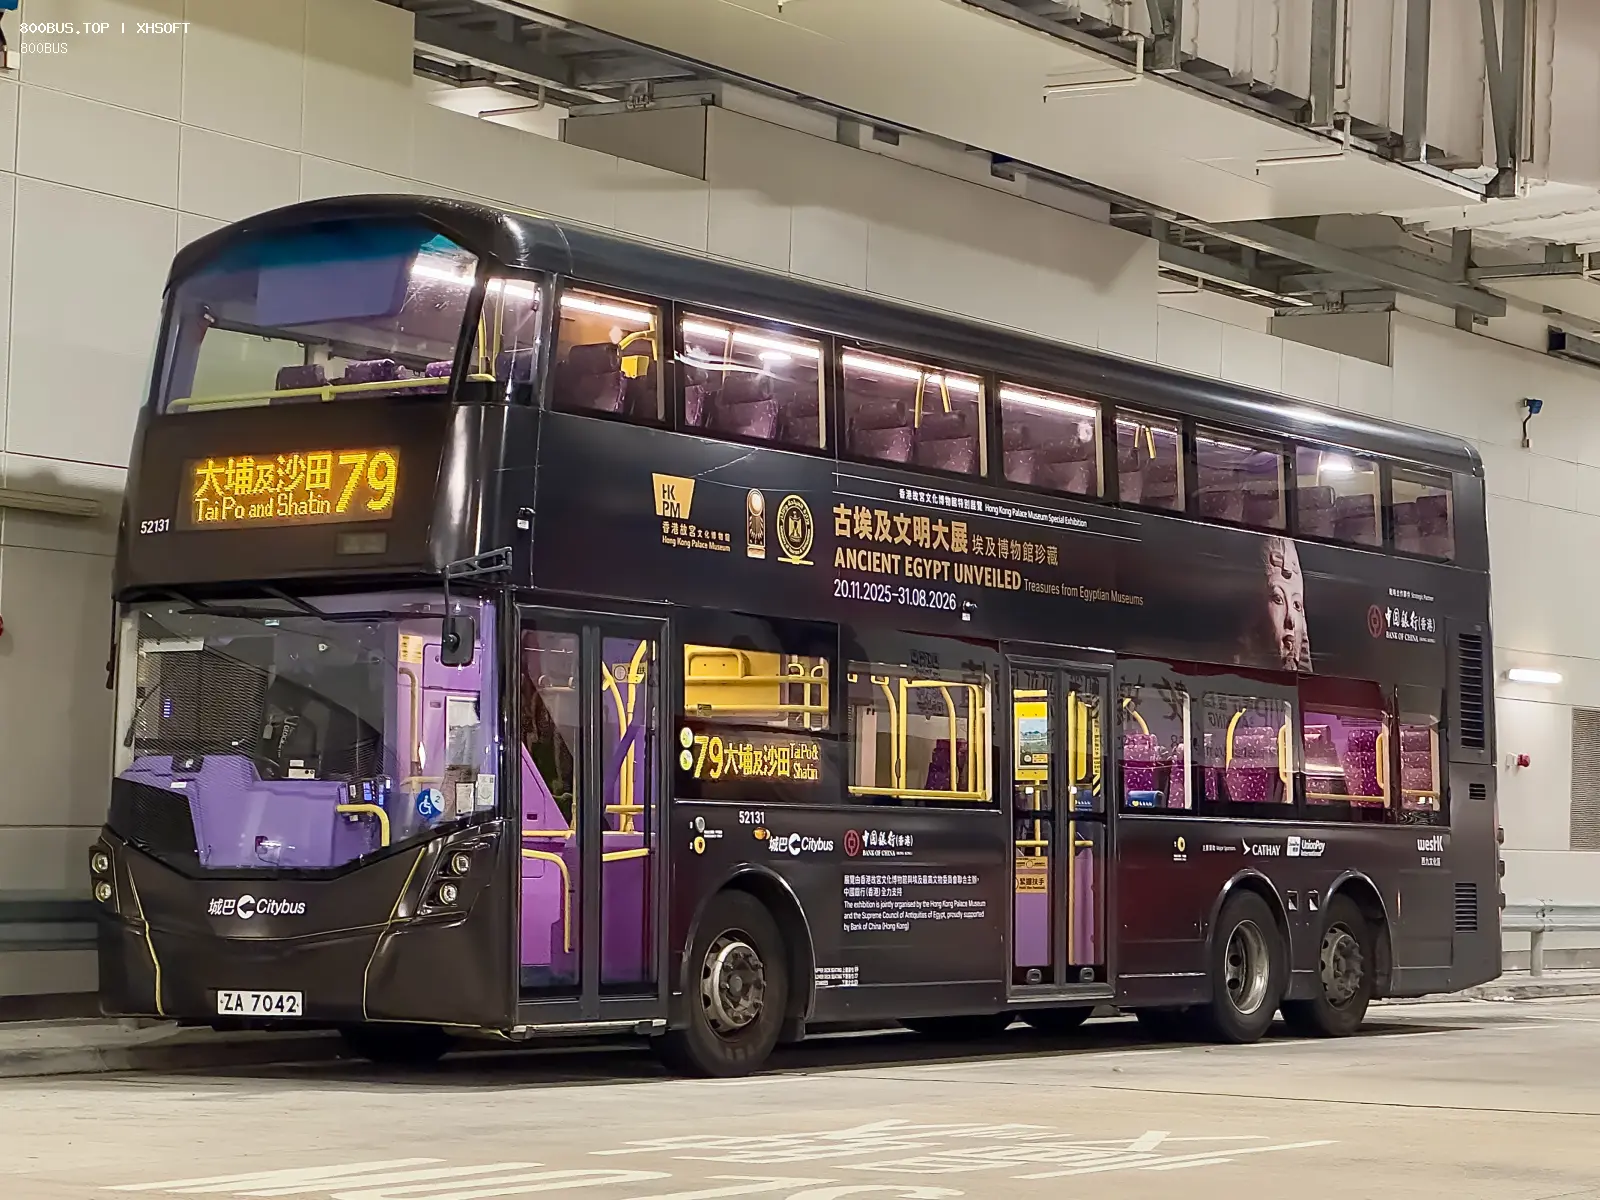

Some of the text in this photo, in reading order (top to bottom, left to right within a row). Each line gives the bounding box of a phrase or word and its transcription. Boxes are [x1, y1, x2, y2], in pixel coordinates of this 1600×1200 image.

[194, 453, 332, 498] 大埔及沙田
[335, 451, 396, 513] 79
[662, 484, 675, 500] HK
[249, 498, 273, 517] and
[277, 491, 331, 516] Shatin
[662, 500, 680, 518] PM
[984, 503, 998, 515] Hong
[998, 505, 1011, 517] Kong
[1012, 507, 1027, 519] Palace
[1027, 510, 1048, 521] Museum
[1048, 513, 1064, 524] Special
[1065, 516, 1087, 527] Exhibition
[140, 518, 170, 534] 52131
[833, 503, 968, 554] 古埃及文明大展
[662, 535, 731, 552] Hong Kong Palace Museum
[972, 533, 1059, 566] 埃及博物館珍藏
[834, 546, 1021, 590] ANCIENT EGYPT UNVEILED
[1023, 578, 1144, 606] Treasures from Egyptian Museums
[1385, 630, 1398, 640] BANK
[1404, 633, 1419, 643] CHINA
[693, 735, 723, 779] 79
[724, 742, 790, 777] 大埔及沙田
[793, 763, 818, 780] Shatin
[739, 811, 765, 824] 52131
[769, 836, 788, 851] 城巴
[801, 837, 834, 852] Citybus
[1252, 844, 1281, 856] CATHAY
[1301, 839, 1325, 854] UnionPay
[862, 849, 875, 857] BANK
[881, 849, 895, 857] CHINA
[207, 898, 236, 915] 城巴
[256, 898, 306, 916] Citybus
[844, 901, 853, 909] The
[853, 900, 875, 909] exhibition
[880, 901, 894, 910] jointly
[894, 900, 916, 910] organised
[916, 901, 922, 909] by
[930, 900, 942, 910] Hong
[942, 900, 954, 910] Kong
[954, 899, 968, 908] Palace
[861, 911, 882, 920] Supreme
[882, 911, 899, 919] Council
[905, 911, 927, 919] Antiquities
[946, 910, 963, 919] proudly
[963, 910, 985, 919] supported
[843, 923, 850, 932] by
[850, 922, 862, 931] Bank
[868, 922, 881, 931] China
[223, 993, 297, 1013] ZA 7042
